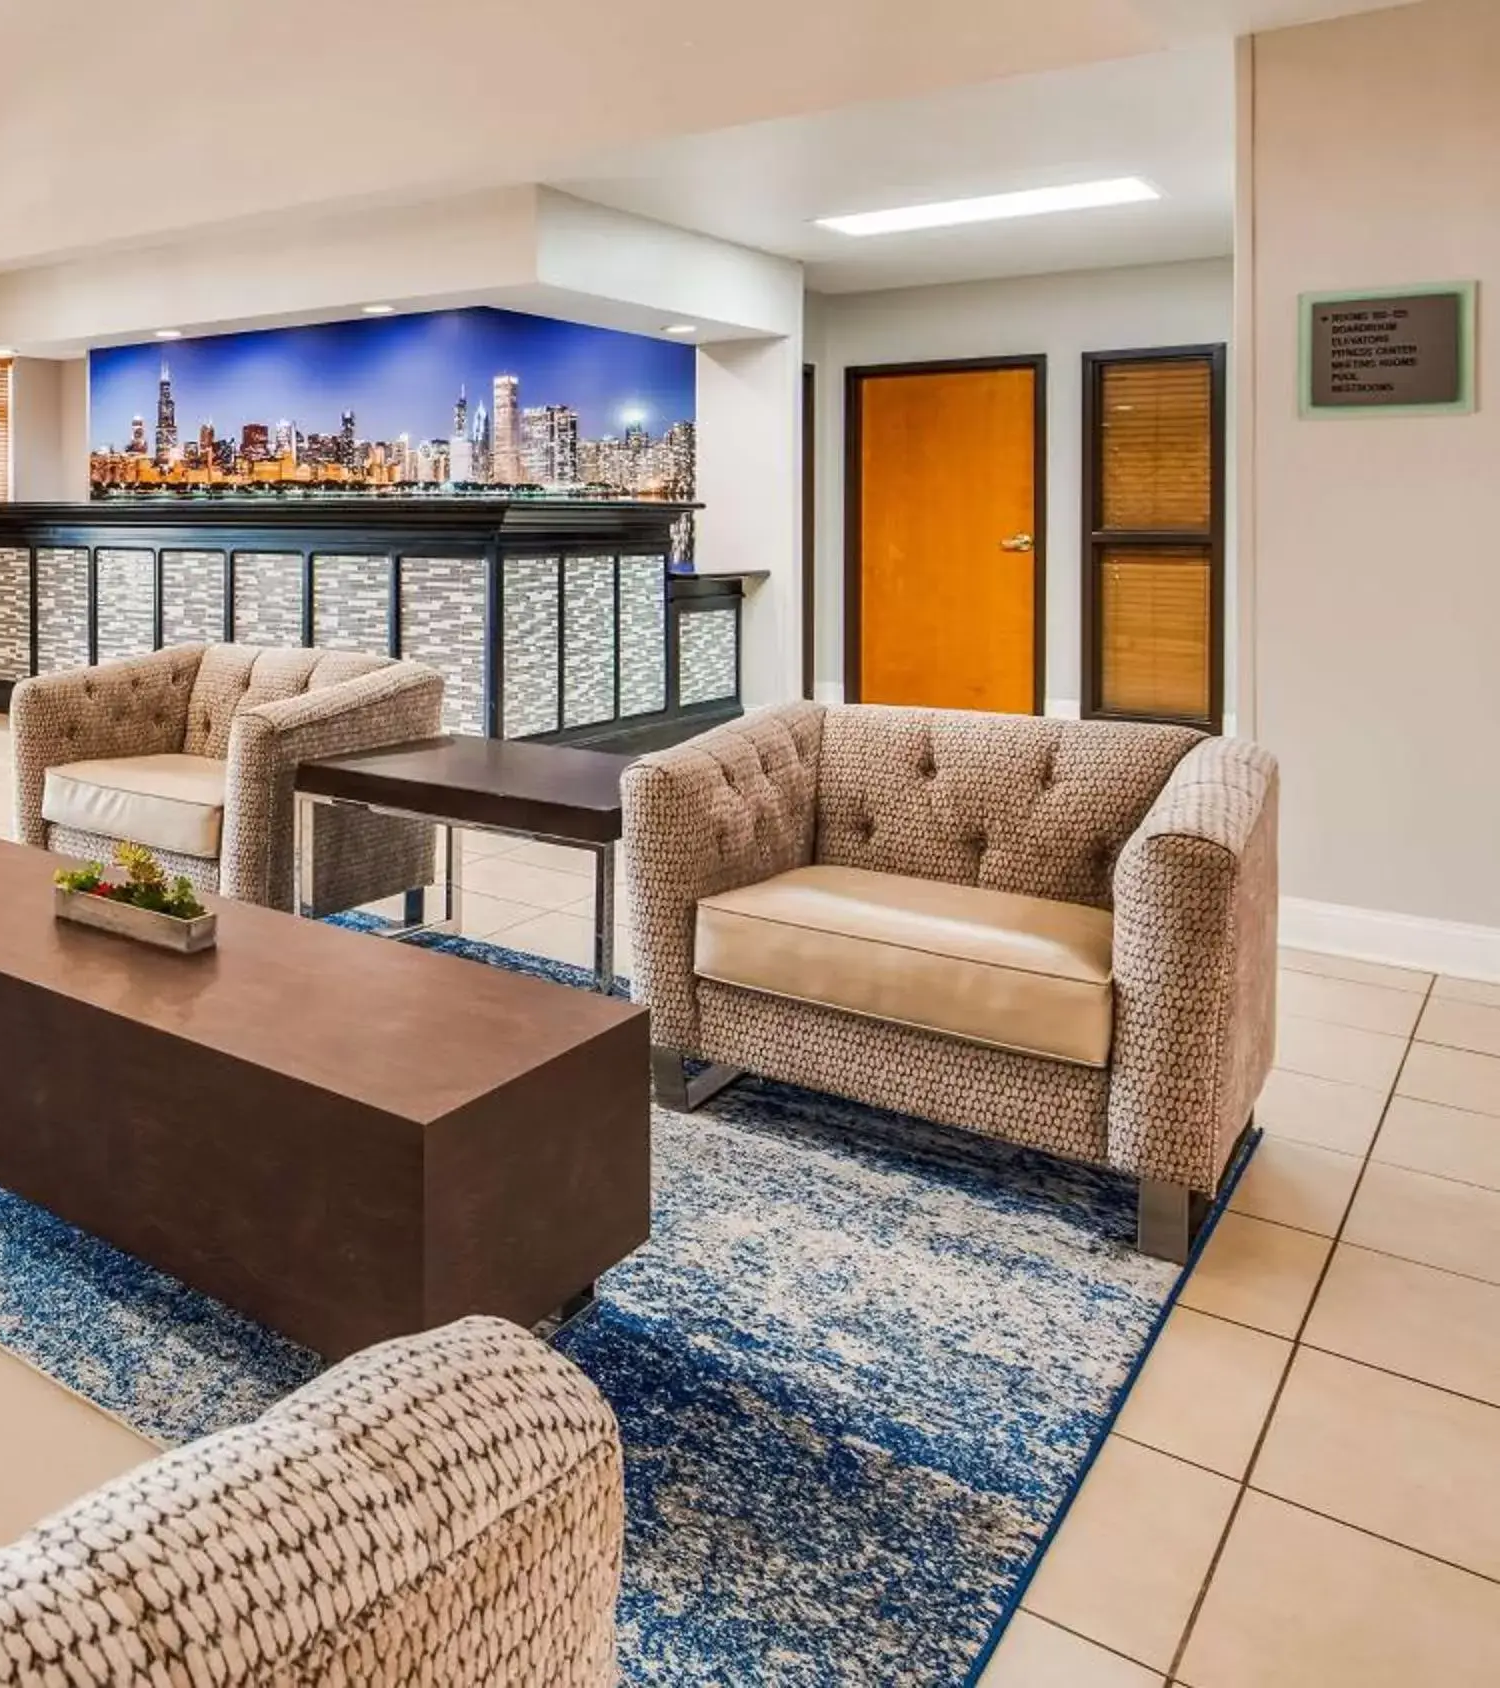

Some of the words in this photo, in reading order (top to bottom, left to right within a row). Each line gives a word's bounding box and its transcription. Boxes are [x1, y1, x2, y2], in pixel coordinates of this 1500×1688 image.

[1331, 323, 1397, 334] BOARDROOM
[1331, 335, 1389, 346] ELEVATORS
[1375, 345, 1417, 355] CENTER
